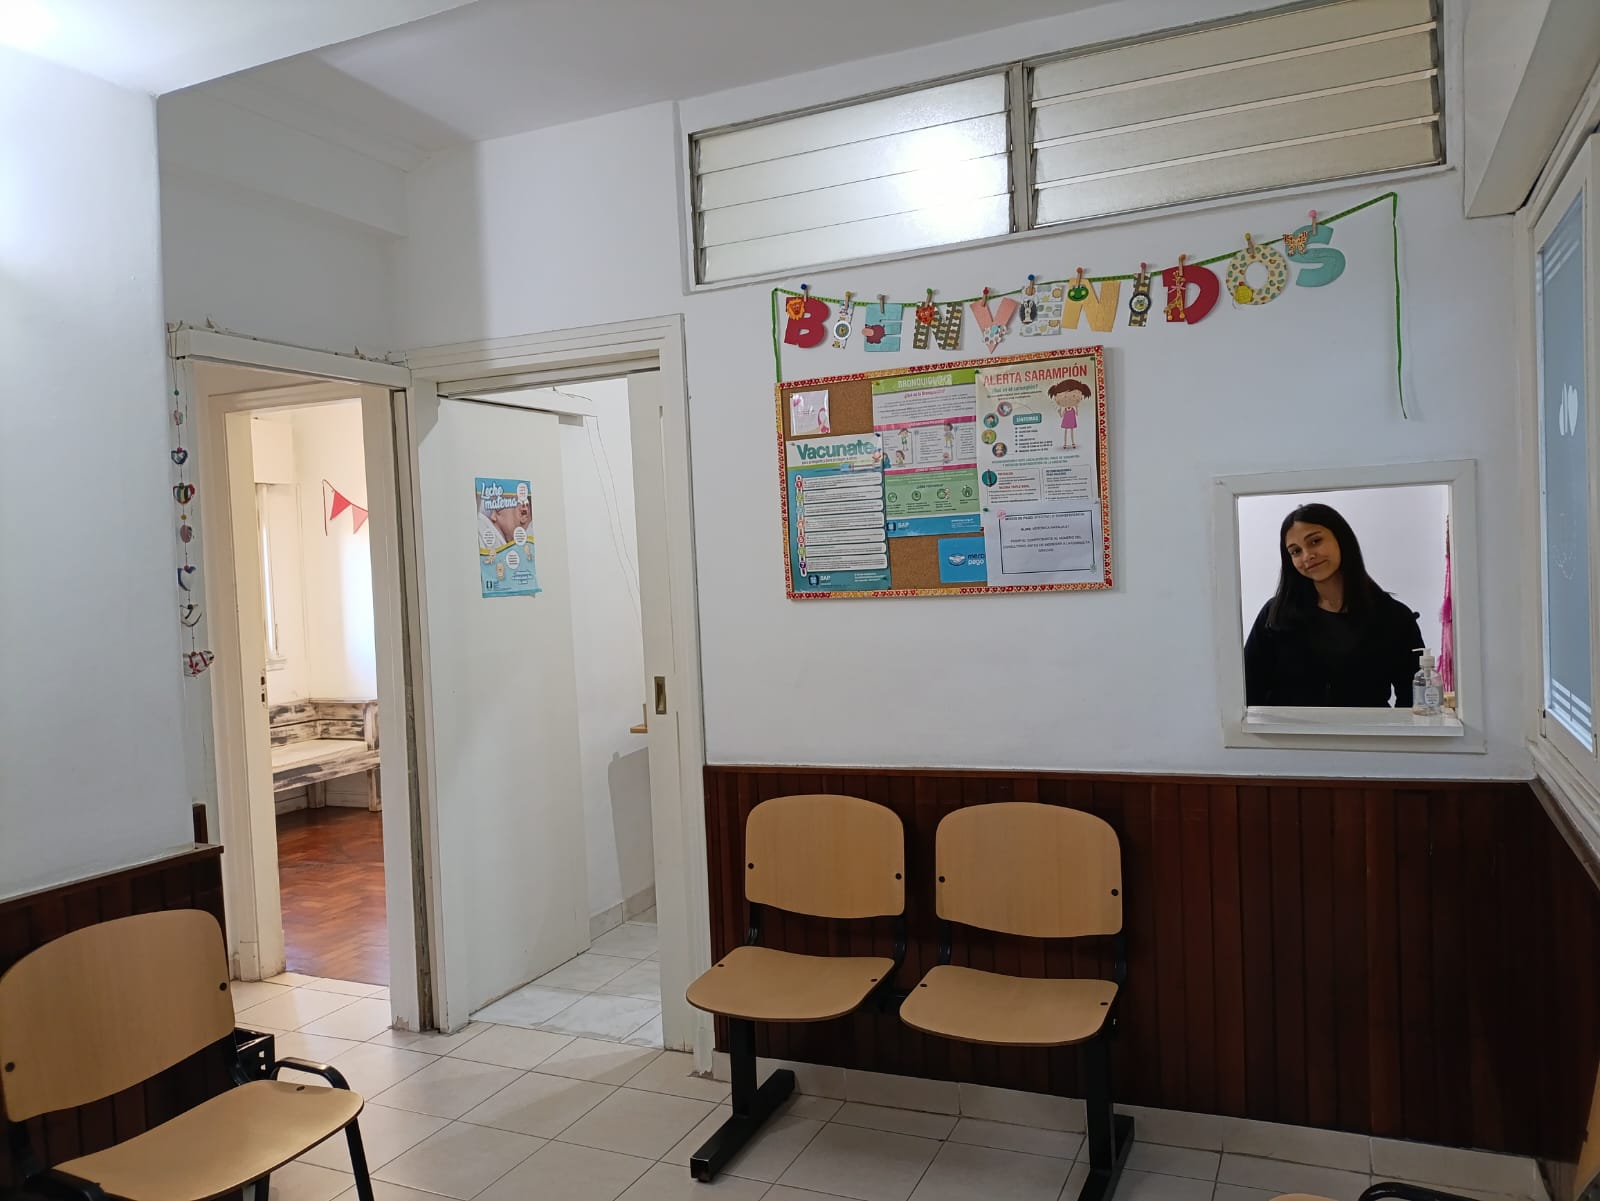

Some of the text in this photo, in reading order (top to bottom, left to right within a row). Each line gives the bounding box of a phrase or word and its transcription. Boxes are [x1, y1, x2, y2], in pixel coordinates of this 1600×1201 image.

[784, 223, 1347, 354] BIENVENIDOS
[983, 362, 1088, 386] ALERTA SARAMPIÓN
[796, 439, 875, 461] Vacunate
[481, 482, 503, 500] Leche
[485, 496, 518, 510] materna
[967, 559, 985, 567] pago
